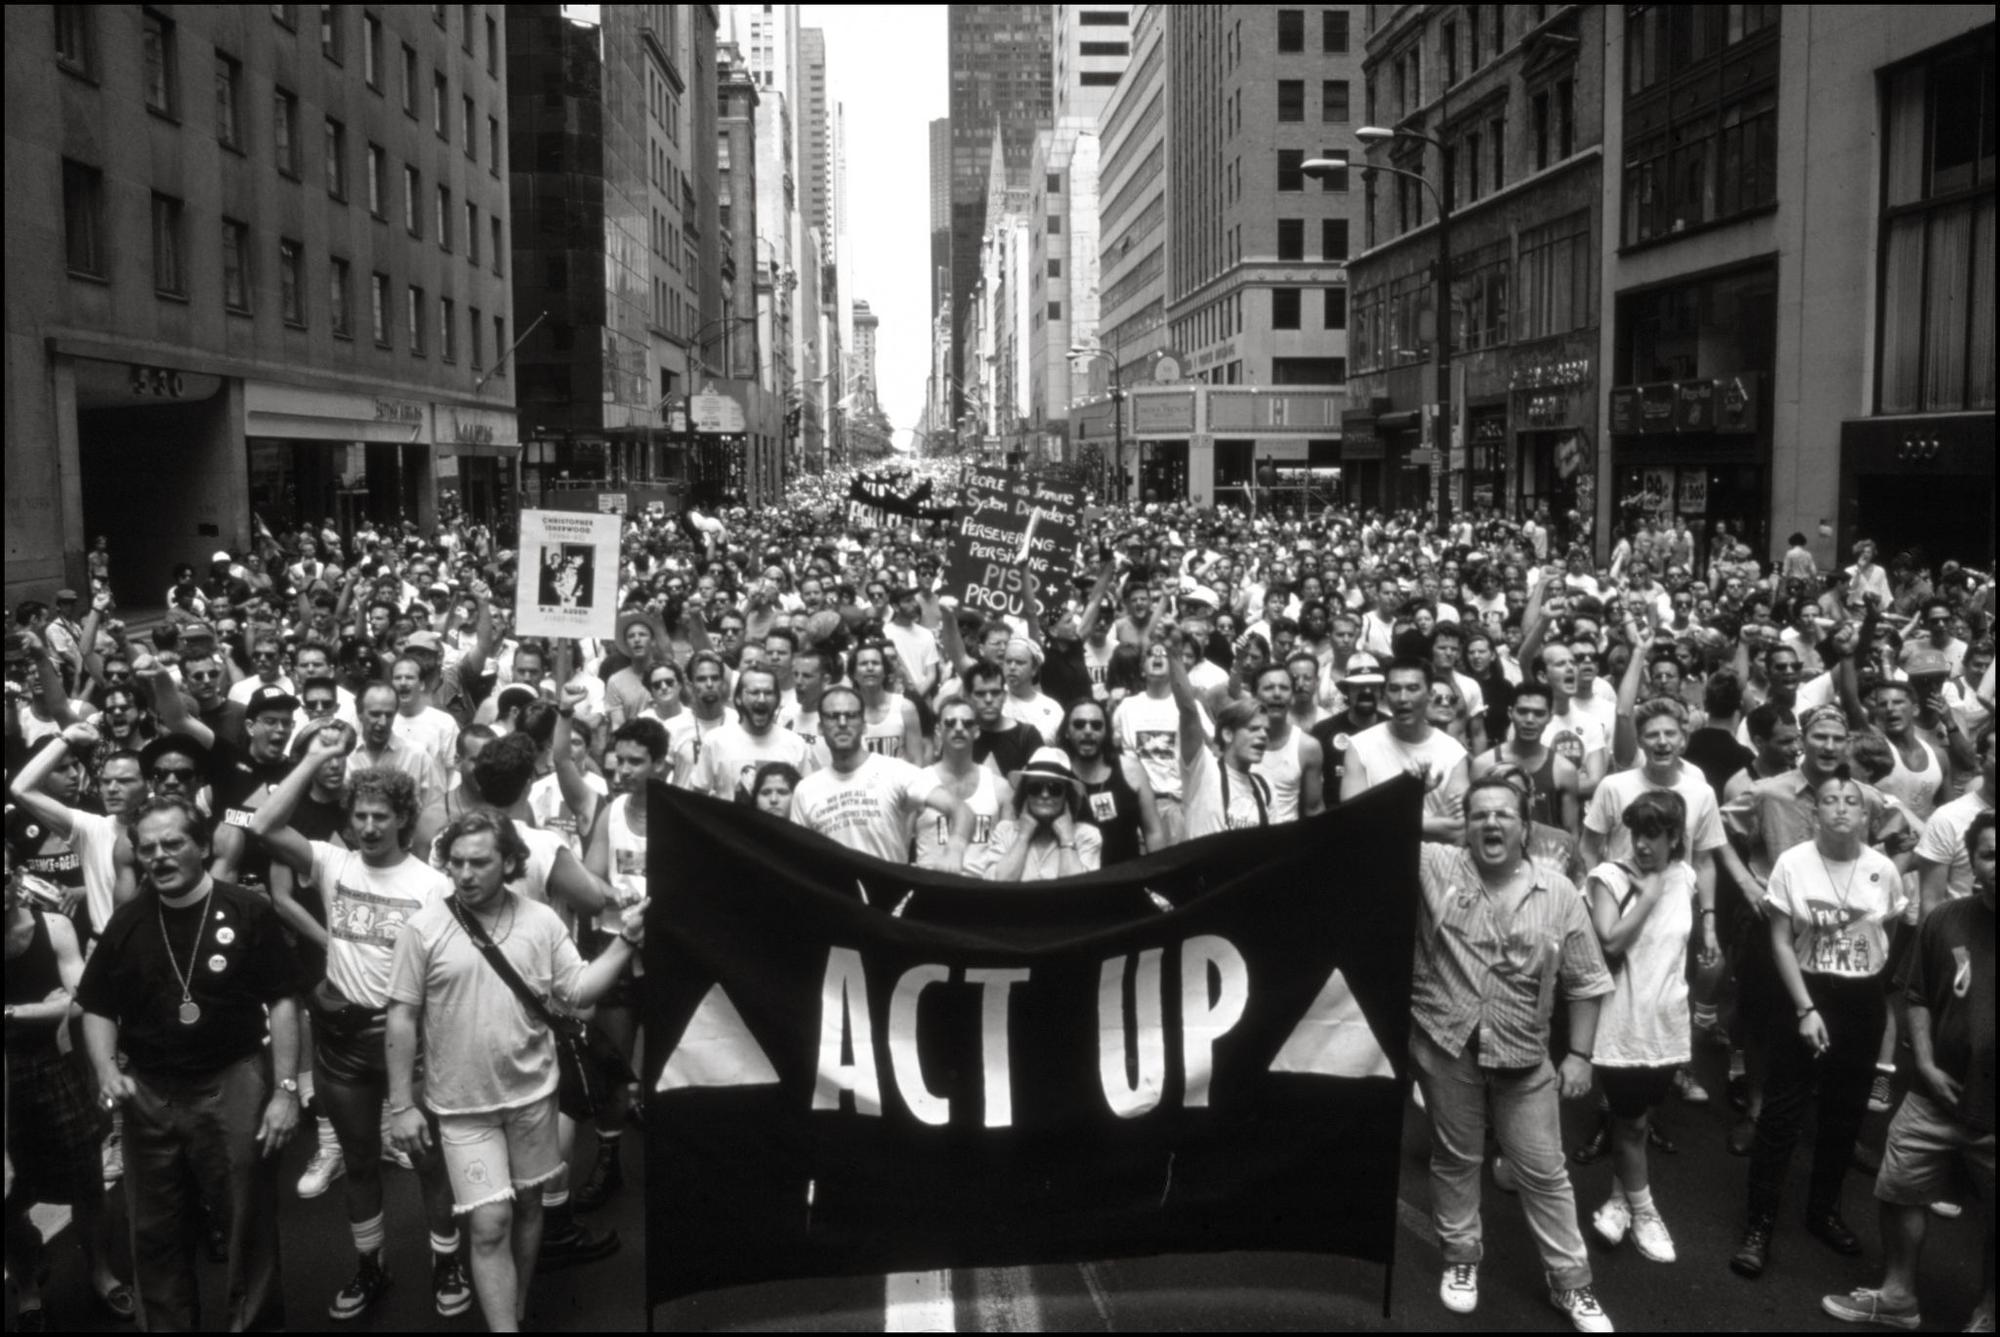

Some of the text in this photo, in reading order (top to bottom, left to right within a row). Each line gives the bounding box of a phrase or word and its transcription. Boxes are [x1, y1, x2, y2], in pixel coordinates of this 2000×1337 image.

[542, 517, 593, 526] CHRISTOPHER
[545, 525, 591, 534] ISHERWOOD
[961, 516, 1055, 552] PERSEVERNG
[563, 608, 588, 616] AUDEN
[811, 934, 1249, 1128] ACT UP
